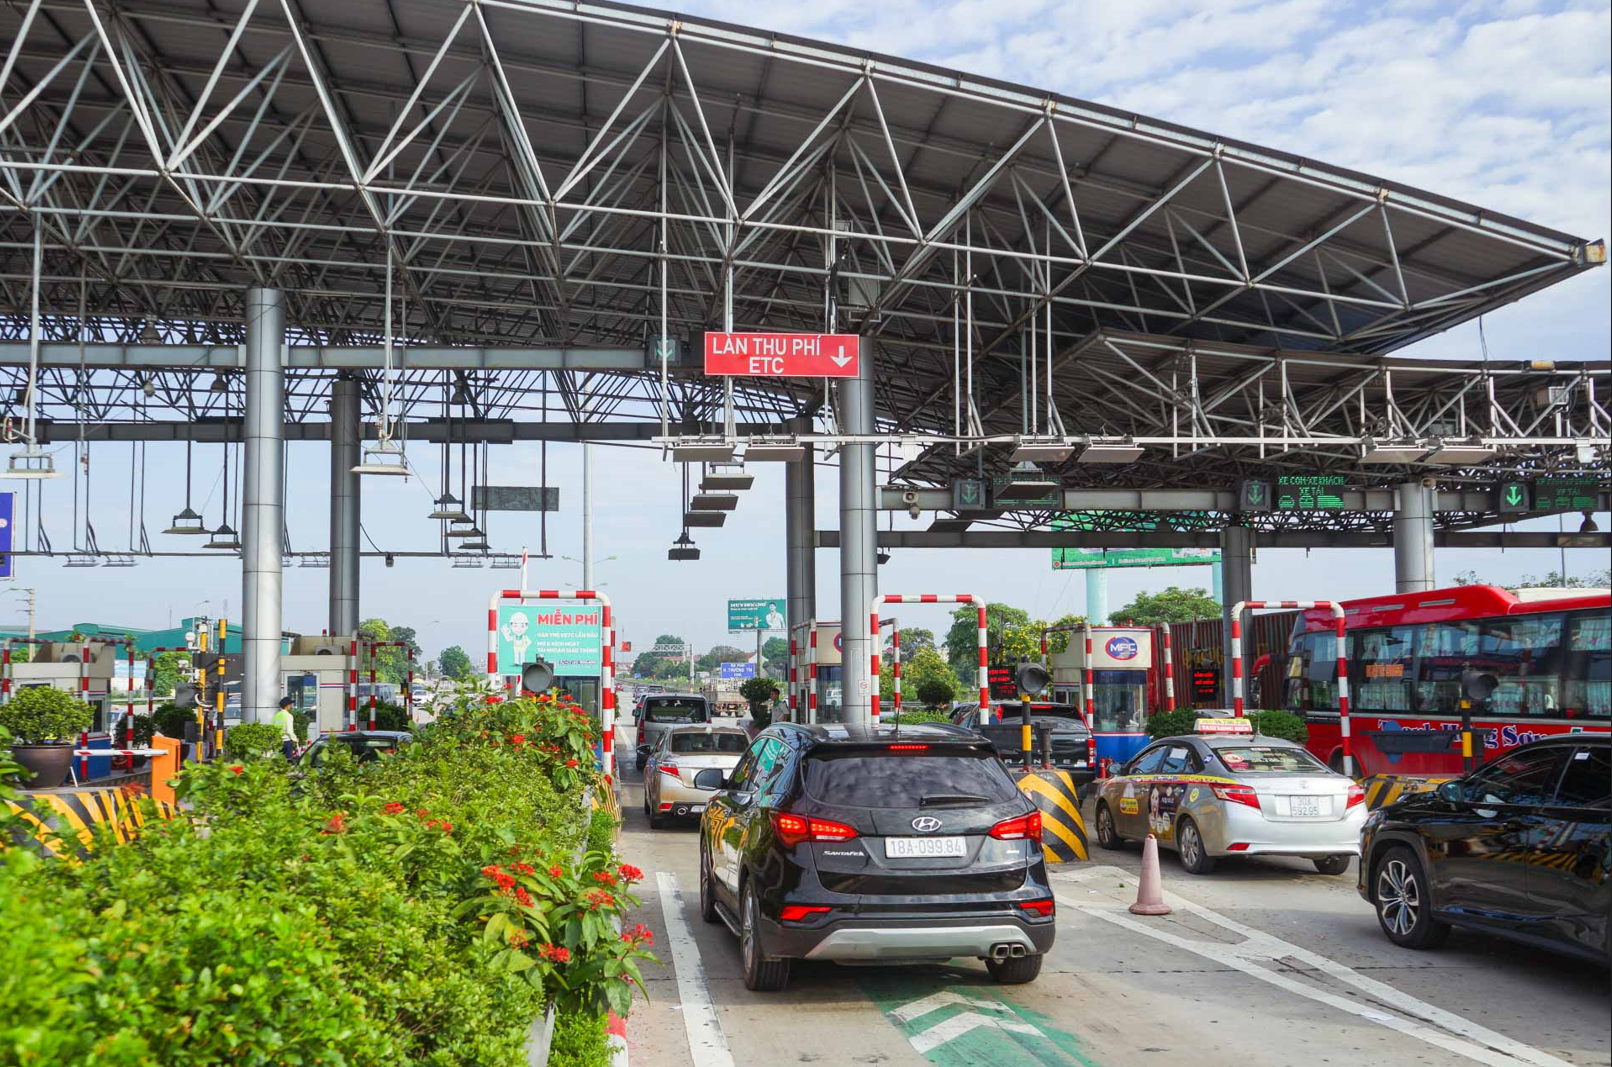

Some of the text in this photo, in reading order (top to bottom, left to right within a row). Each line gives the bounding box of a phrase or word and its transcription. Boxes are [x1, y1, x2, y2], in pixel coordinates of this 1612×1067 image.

[712, 333, 821, 356] LÀN THU PHÍ
[749, 356, 784, 374] ETC
[537, 608, 599, 625] MIỄN PHÍ
[1109, 643, 1136, 652] MPC
